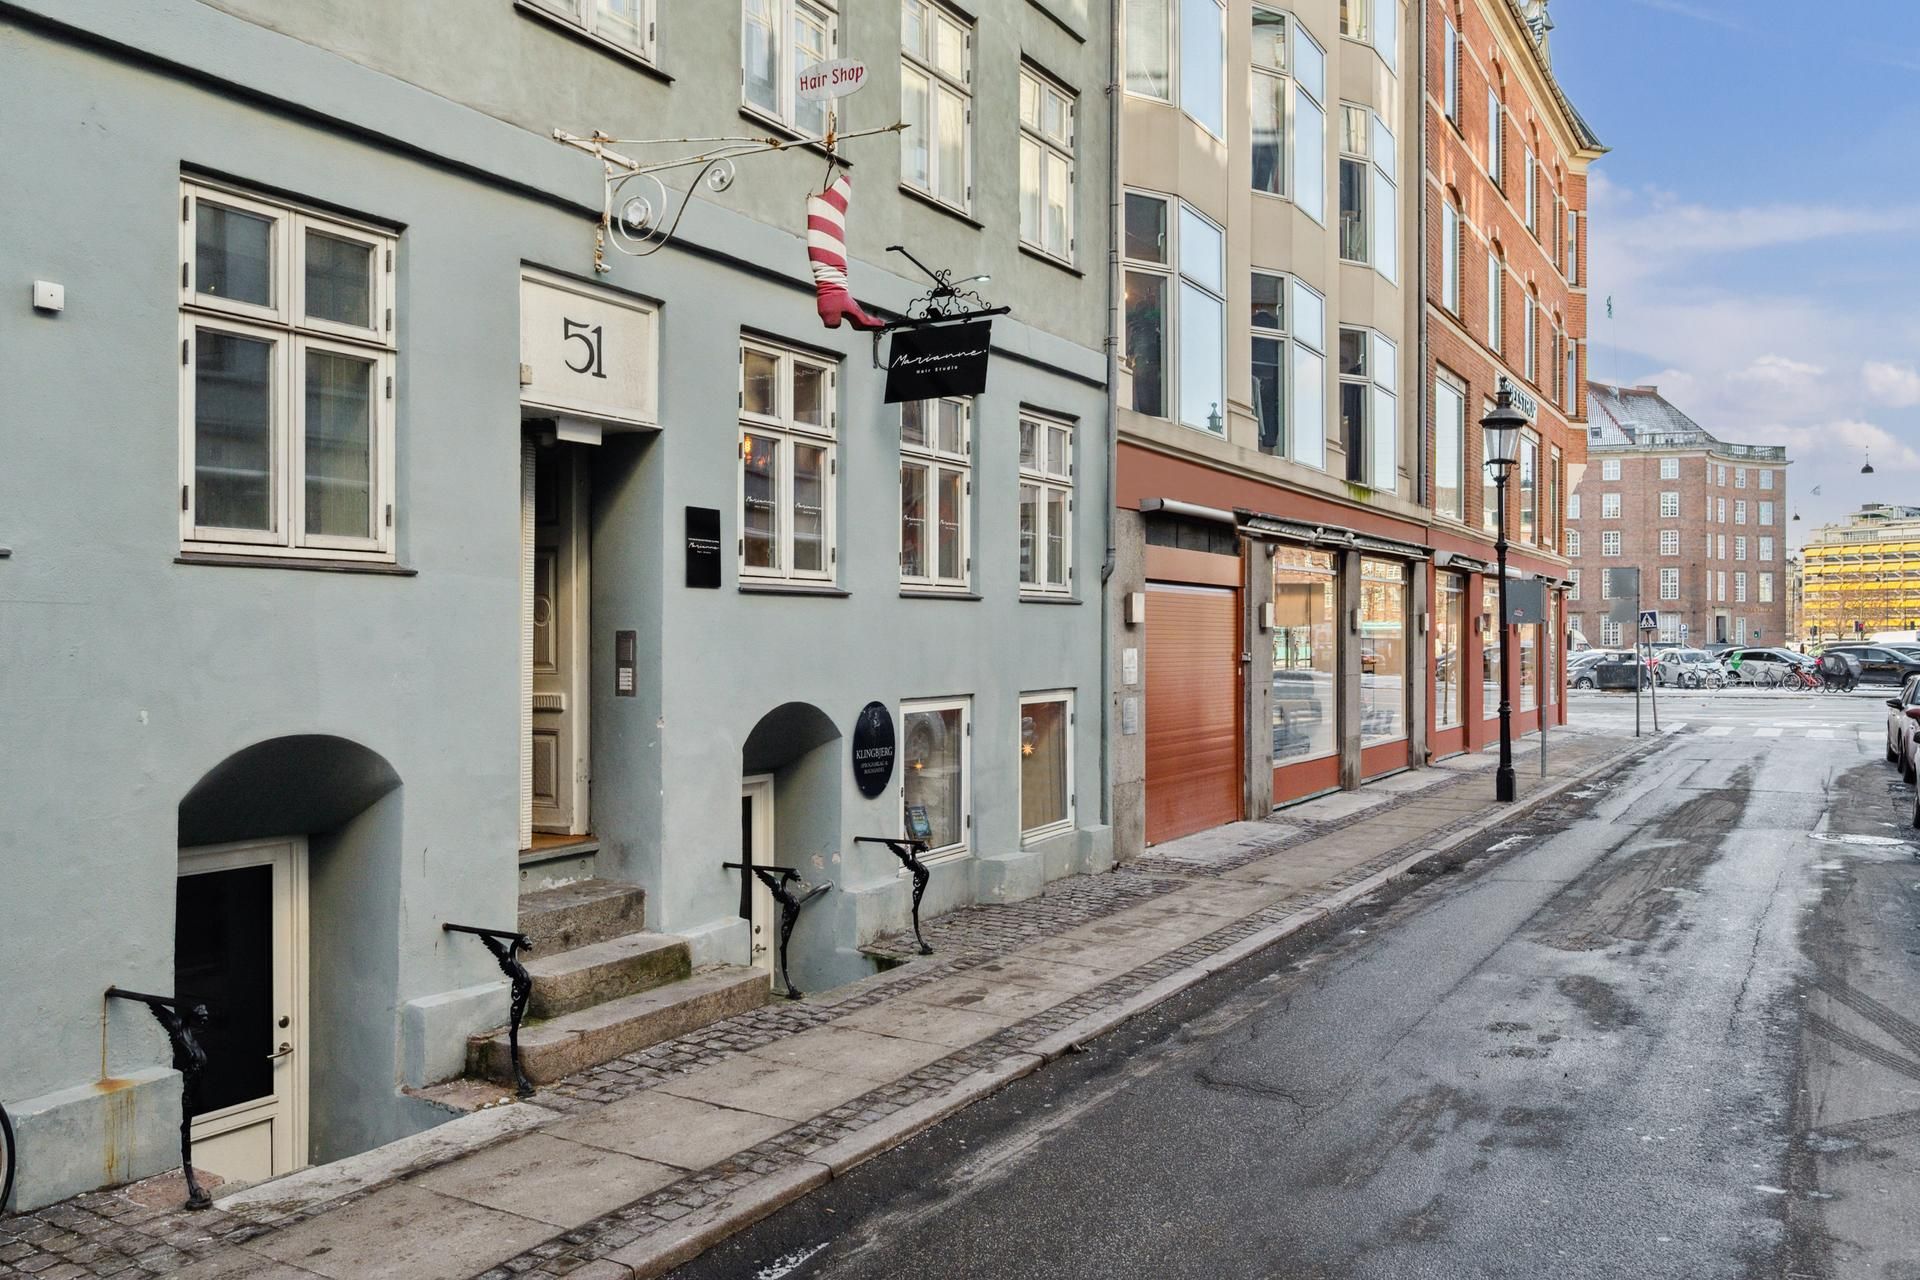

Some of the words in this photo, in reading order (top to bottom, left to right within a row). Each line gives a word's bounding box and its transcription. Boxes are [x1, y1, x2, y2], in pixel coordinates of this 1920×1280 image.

[800, 73, 828, 91] Hair
[832, 66, 864, 85] Shop
[563, 317, 608, 379] 51
